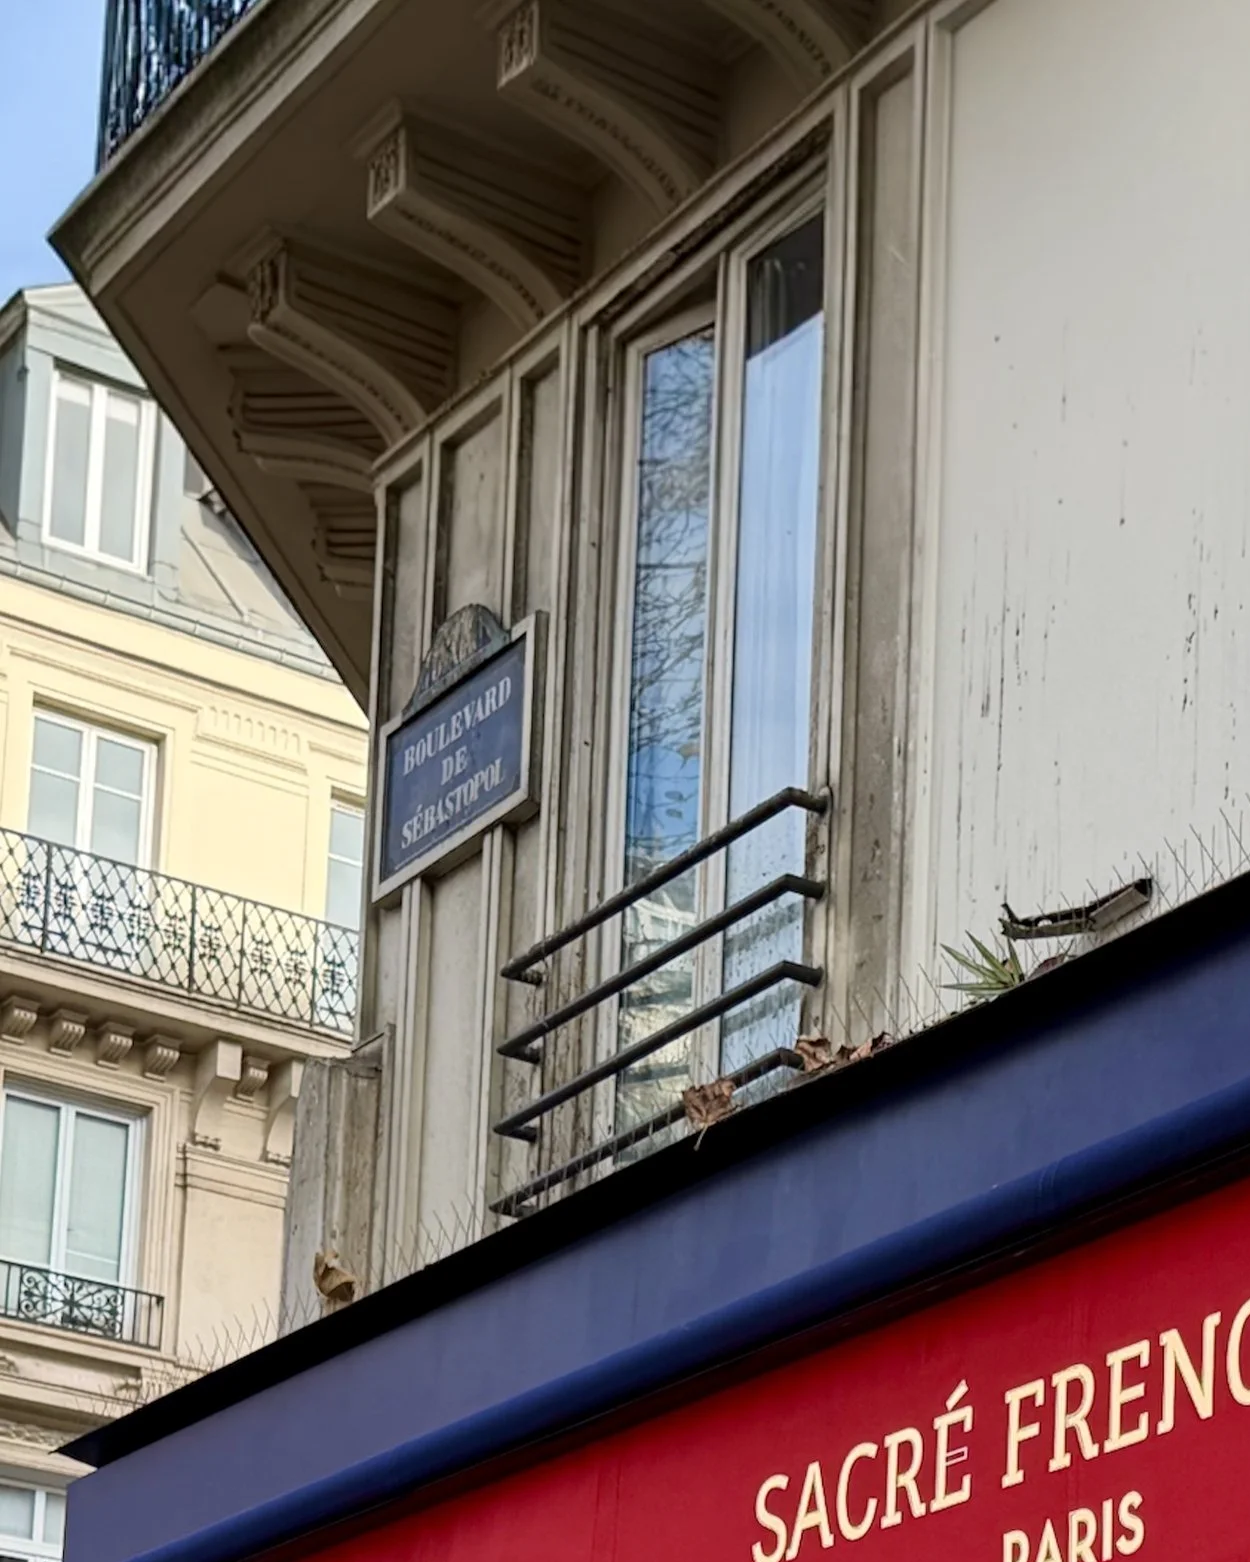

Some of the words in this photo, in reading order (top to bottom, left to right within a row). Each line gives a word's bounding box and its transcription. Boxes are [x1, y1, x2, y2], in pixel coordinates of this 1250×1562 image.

[403, 676, 511, 776] BOULEVARD
[440, 746, 467, 785] DE
[401, 757, 505, 850] SÉBASTOPOL
